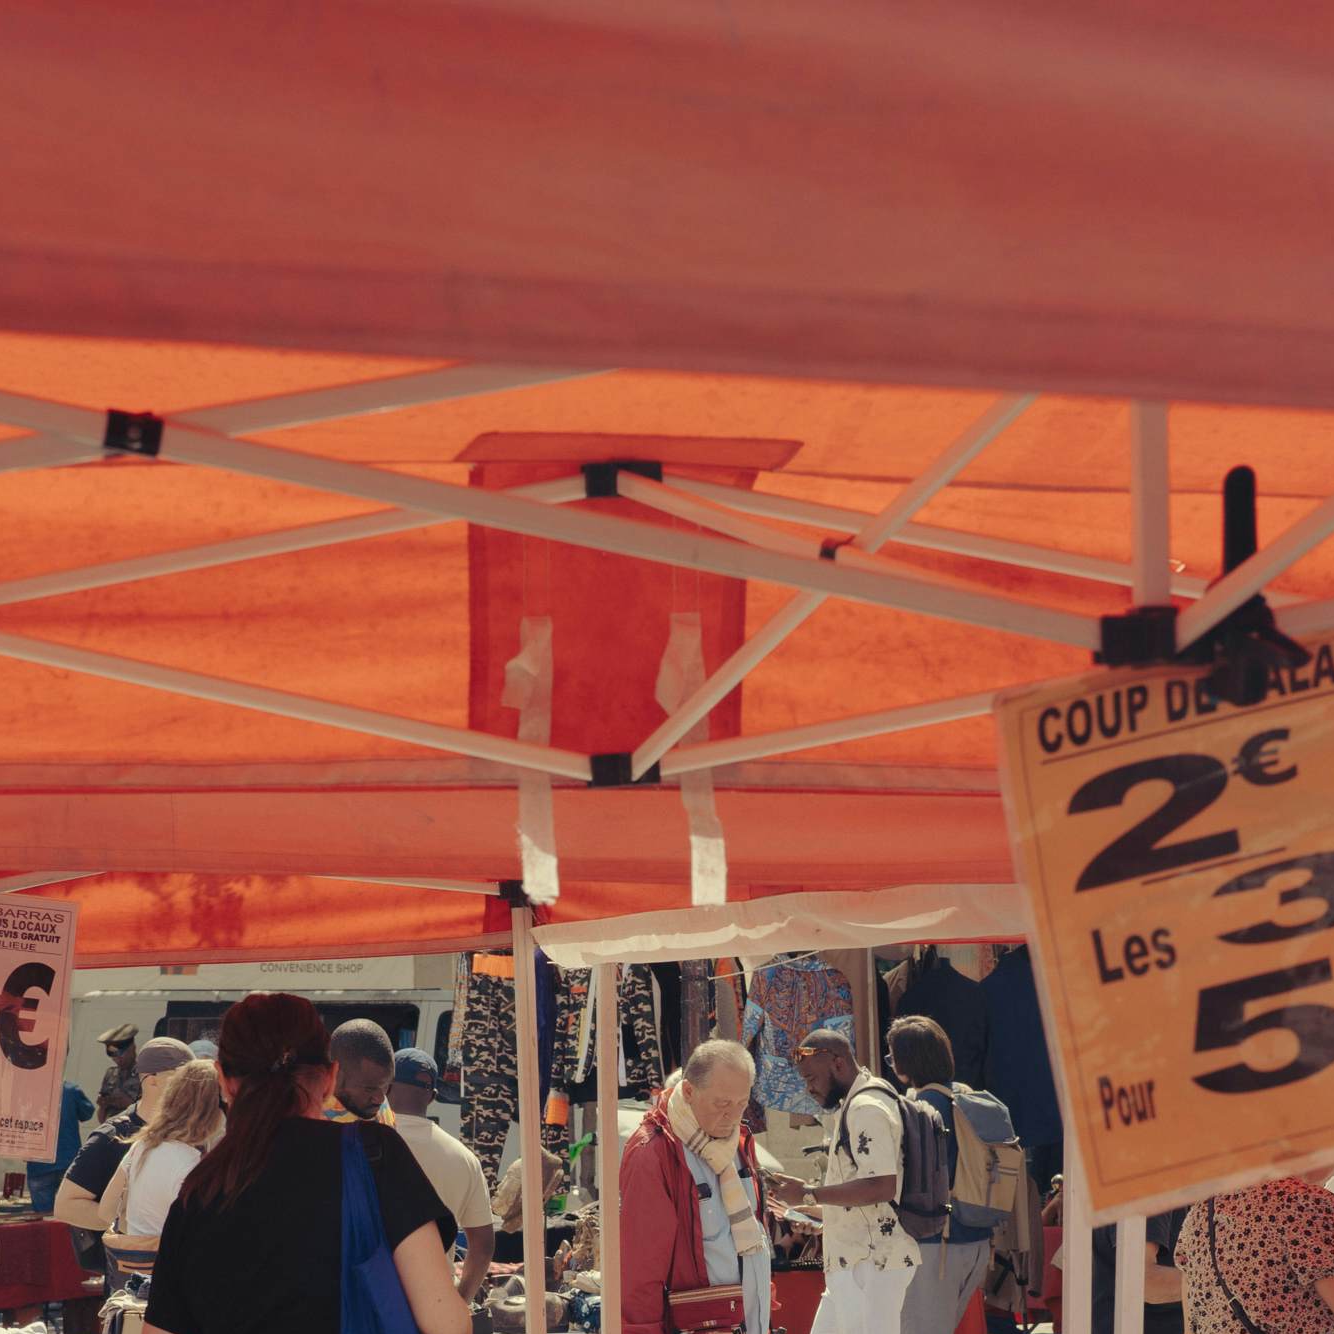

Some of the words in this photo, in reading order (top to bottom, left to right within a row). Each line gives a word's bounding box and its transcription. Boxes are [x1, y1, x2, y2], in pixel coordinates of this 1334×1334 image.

[1037, 685, 1148, 753] COUP
[12, 920, 57, 934] LOCAUX
[21, 933, 61, 944] GRATUIT
[1092, 926, 1176, 985] Les
[259, 963, 334, 974] CONVENIENCE
[336, 963, 364, 974] SHOP
[1100, 1076, 1158, 1130] Pour
[0, 1116, 13, 1128] cet
